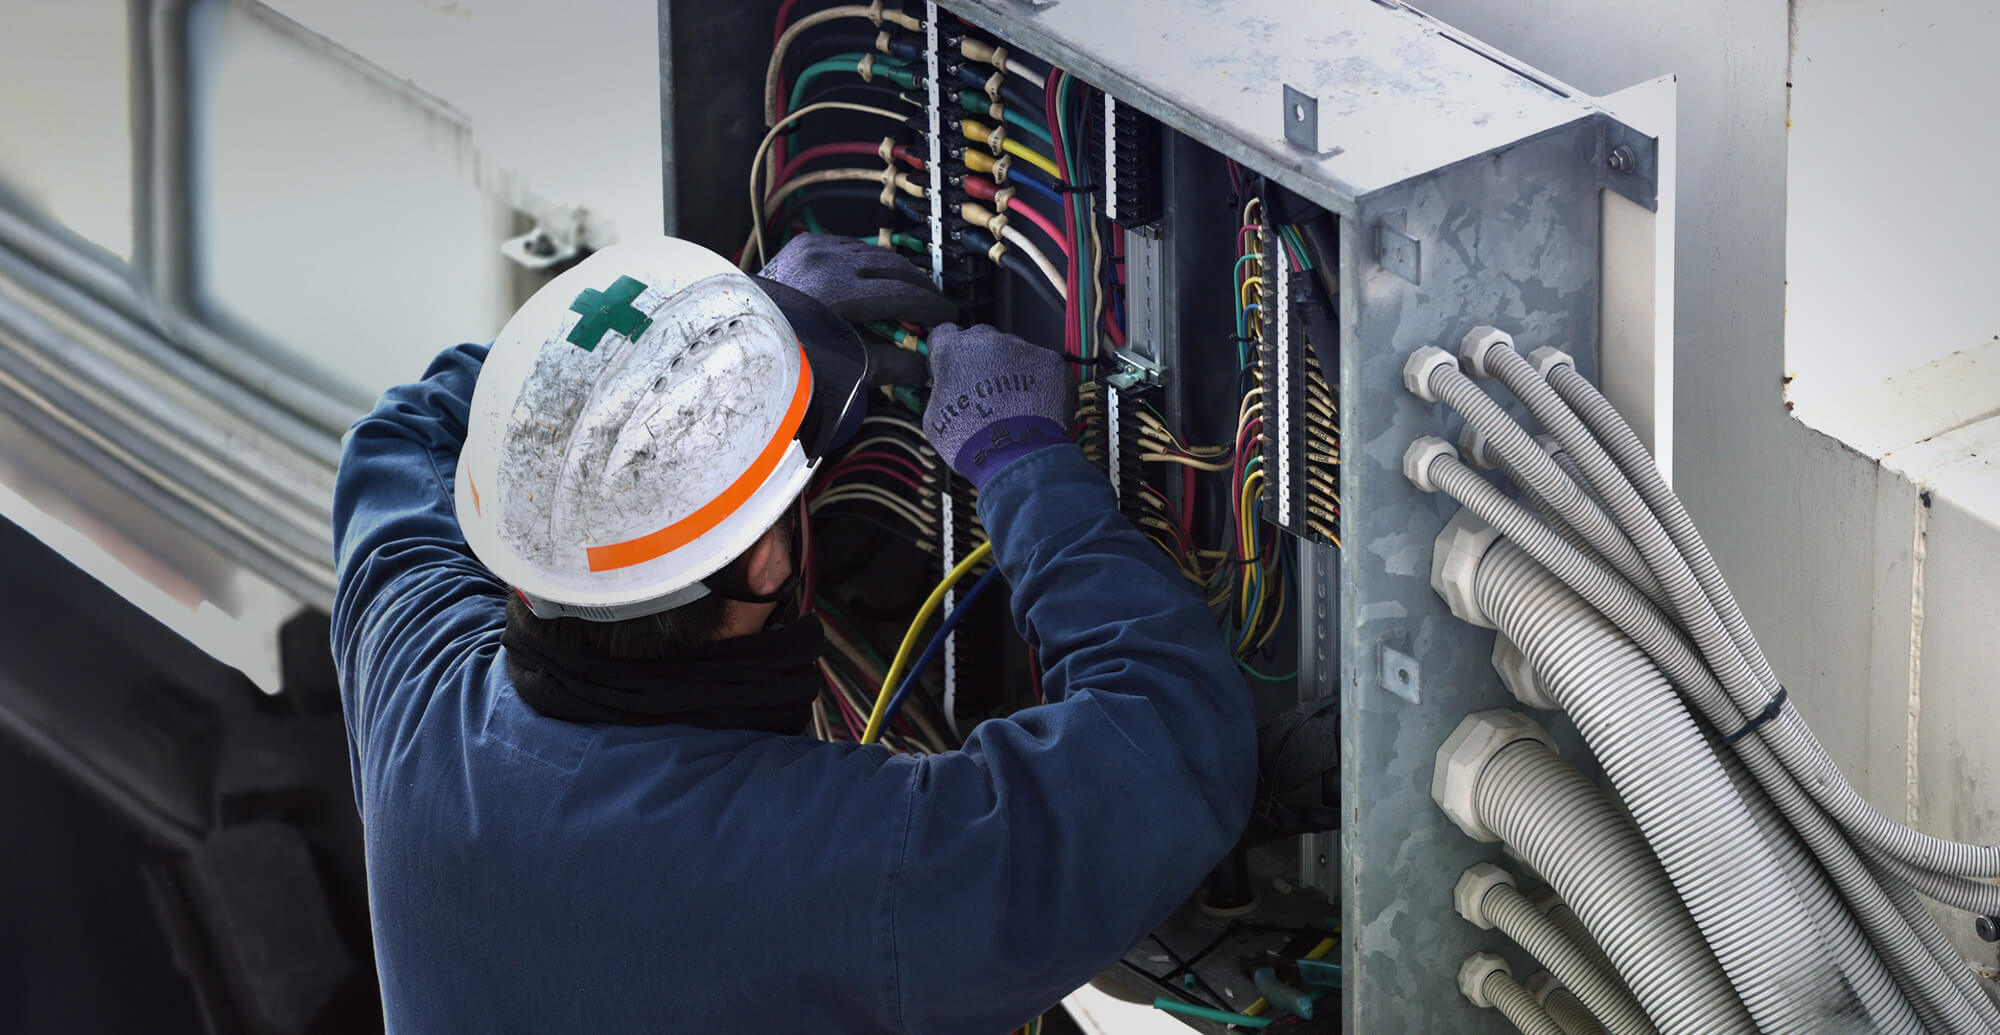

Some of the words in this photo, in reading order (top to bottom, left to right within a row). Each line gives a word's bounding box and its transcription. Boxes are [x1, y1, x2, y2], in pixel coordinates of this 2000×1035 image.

[932, 392, 970, 436] Lite
[975, 373, 1035, 397] GRIP
[975, 402, 993, 420] L
